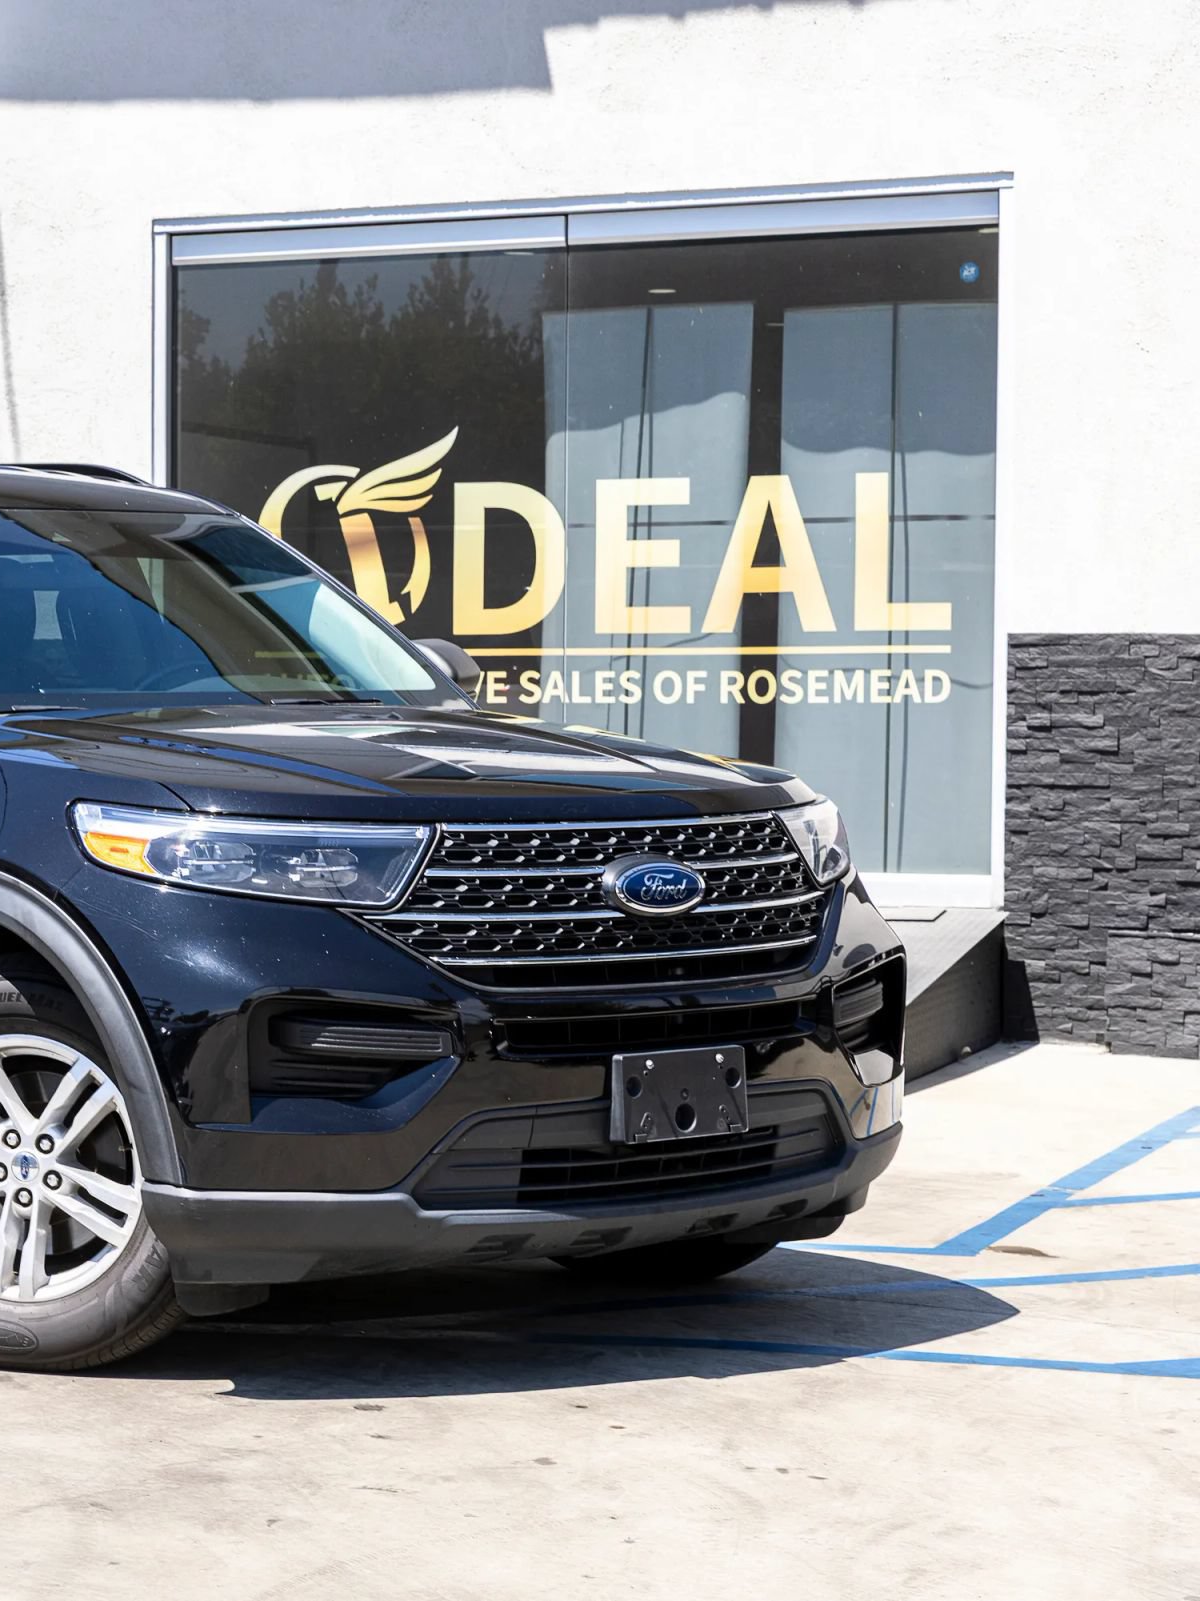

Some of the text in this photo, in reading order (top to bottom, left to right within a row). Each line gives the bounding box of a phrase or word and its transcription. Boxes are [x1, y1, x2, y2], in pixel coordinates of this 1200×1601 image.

[518, 669, 641, 705] SALES
[652, 669, 707, 704] OF
[721, 668, 952, 705] ROSEMEAD
[640, 872, 688, 900] Ford
